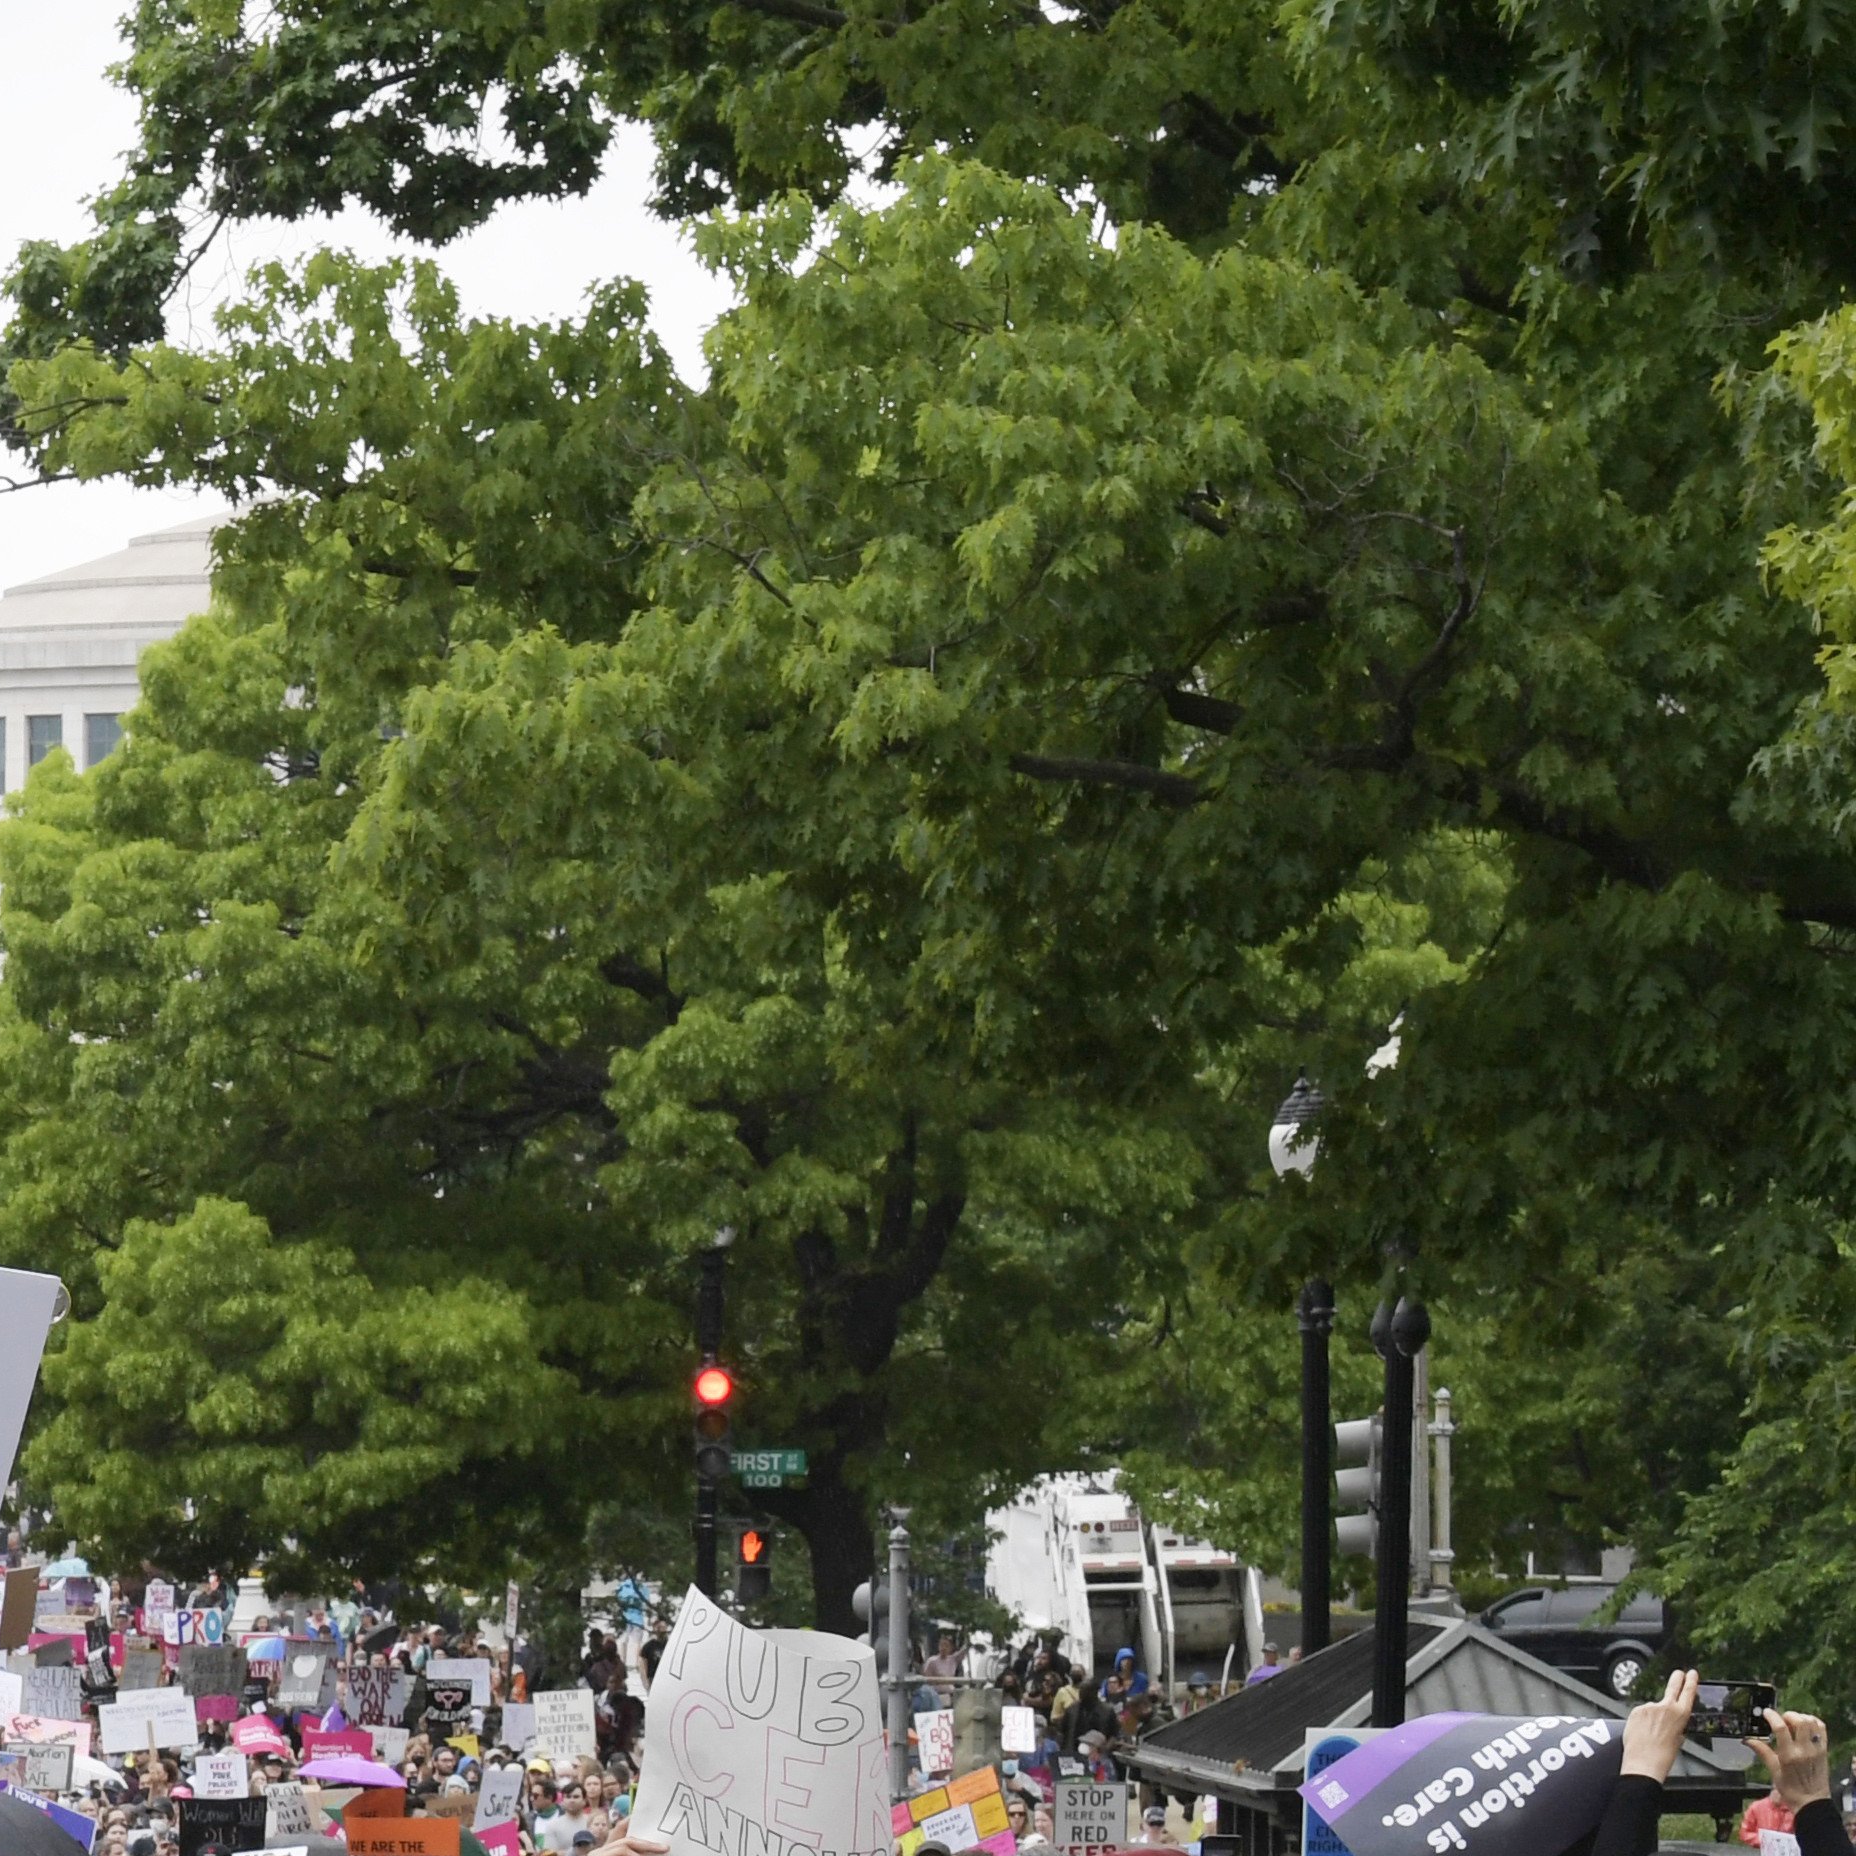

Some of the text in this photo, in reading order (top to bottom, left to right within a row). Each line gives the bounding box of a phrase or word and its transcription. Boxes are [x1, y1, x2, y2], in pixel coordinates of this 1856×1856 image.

[730, 1453, 782, 1471] FIRST
[747, 1474, 782, 1487] 100
[178, 1611, 223, 1645] PRO
[349, 1667, 398, 1683] END THE
[351, 1682, 392, 1700] WAR
[360, 1700, 385, 1717] ON
[538, 1713, 584, 1723] POLITICS
[537, 1723, 590, 1734] ABORTIONS
[547, 1735, 574, 1745] SAVE
[553, 1744, 582, 1754] IVES
[1382, 1716, 1586, 1827] ealth Care.
[1427, 1718, 1610, 1854] Abortion is
[1067, 1790, 1114, 1806] STOP
[1065, 1810, 1116, 1821] HERE ON
[1071, 1826, 1108, 1843] RED
[350, 1840, 425, 1852] WE ARE THE
